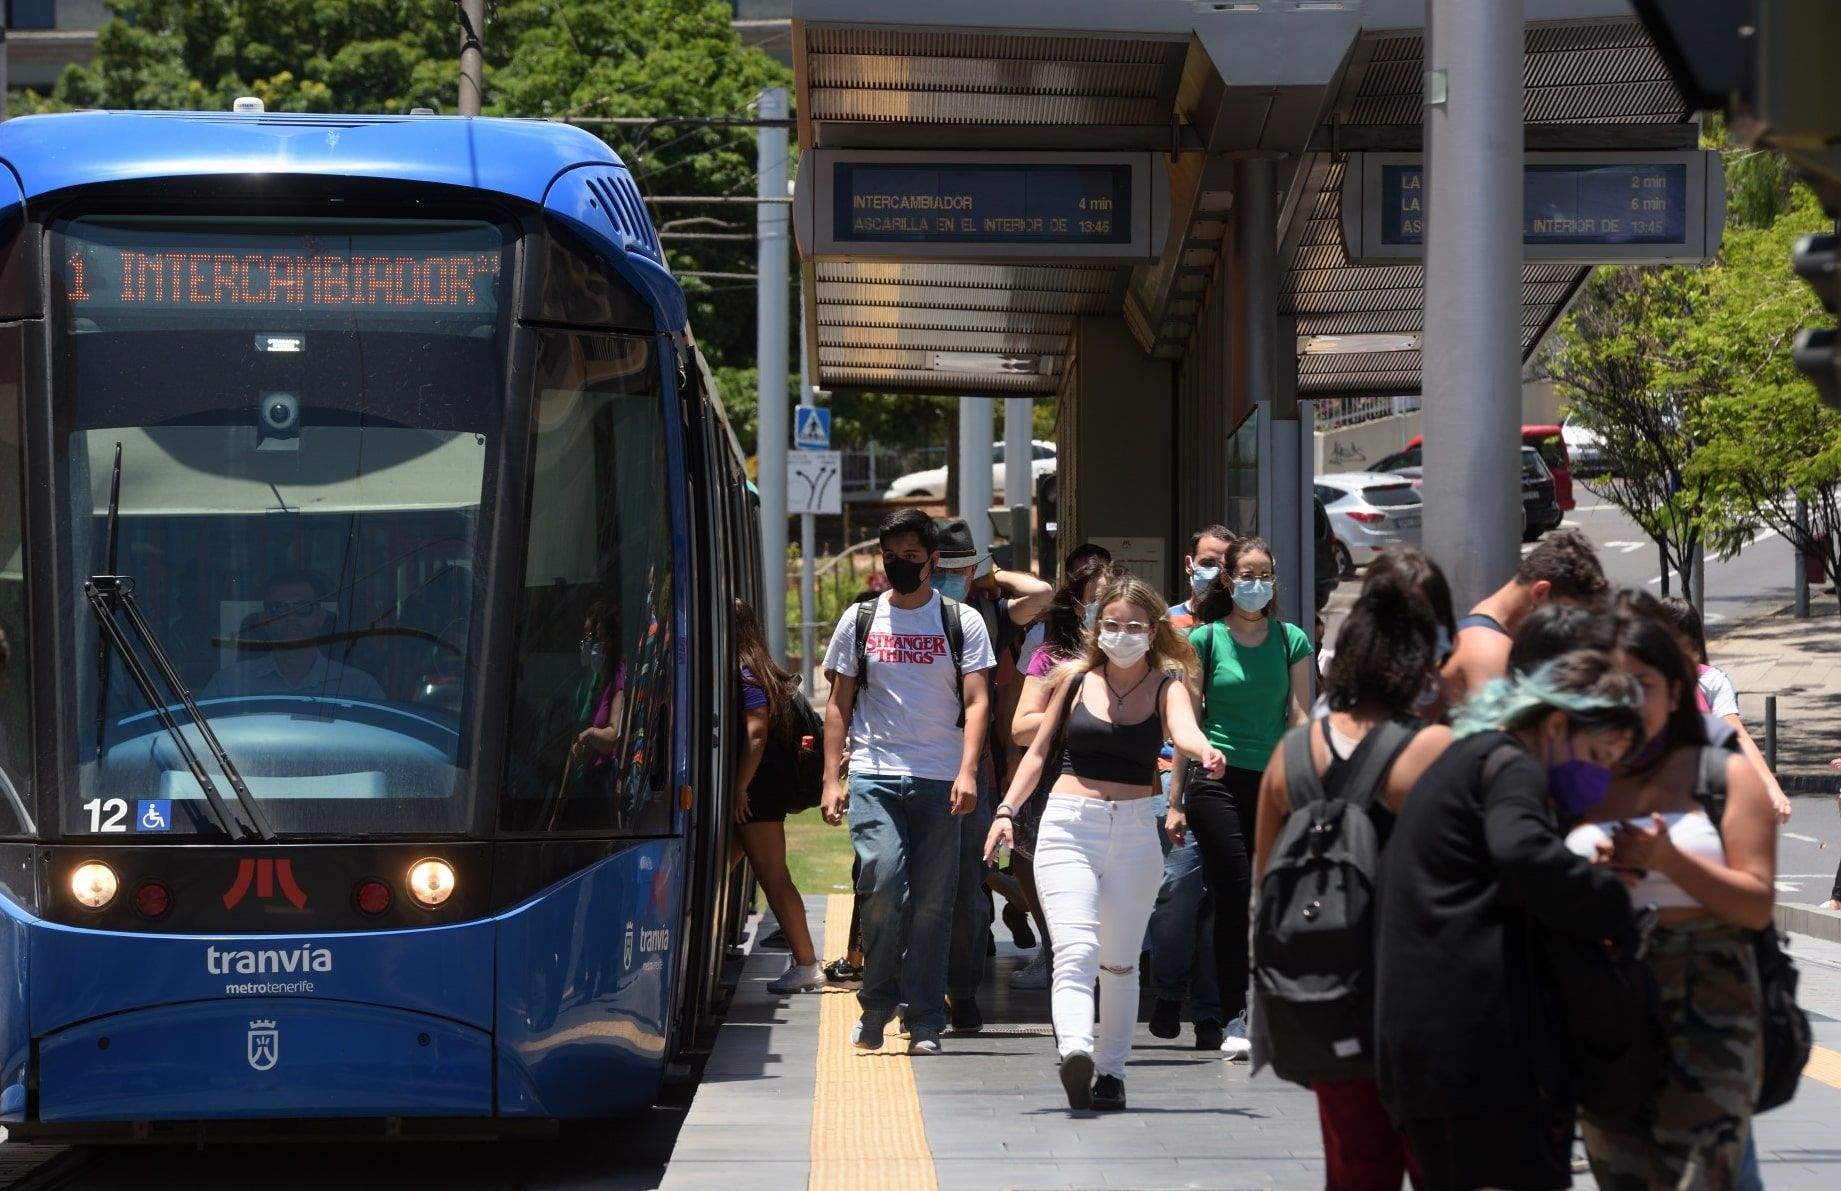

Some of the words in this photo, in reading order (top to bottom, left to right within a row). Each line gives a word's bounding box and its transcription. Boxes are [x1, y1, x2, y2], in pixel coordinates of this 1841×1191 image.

[1631, 176, 1640, 188] 2
[1643, 175, 1666, 188] min
[853, 195, 973, 210] INTERCAMBIADOR
[1078, 197, 1087, 210] 4
[1090, 196, 1113, 210] min
[1402, 198, 1421, 211] LA
[1631, 198, 1640, 210] 6
[1643, 197, 1667, 210] min
[853, 217, 929, 231] ASCARILLA
[937, 218, 954, 232] EN
[961, 218, 977, 232] EL
[983, 218, 1043, 232] INTERIOR
[1051, 218, 1068, 232] DE
[1533, 218, 1596, 233] INTERIOR
[1602, 219, 1620, 233] DE
[68, 253, 90, 301] 1
[120, 252, 478, 305] INTERCAMBIADOR
[866, 632, 947, 656] STRANGER
[878, 648, 935, 665] THINGS
[83, 798, 128, 833] 12
[207, 943, 333, 975] tranvía
[225, 980, 315, 995] metrotenerife
